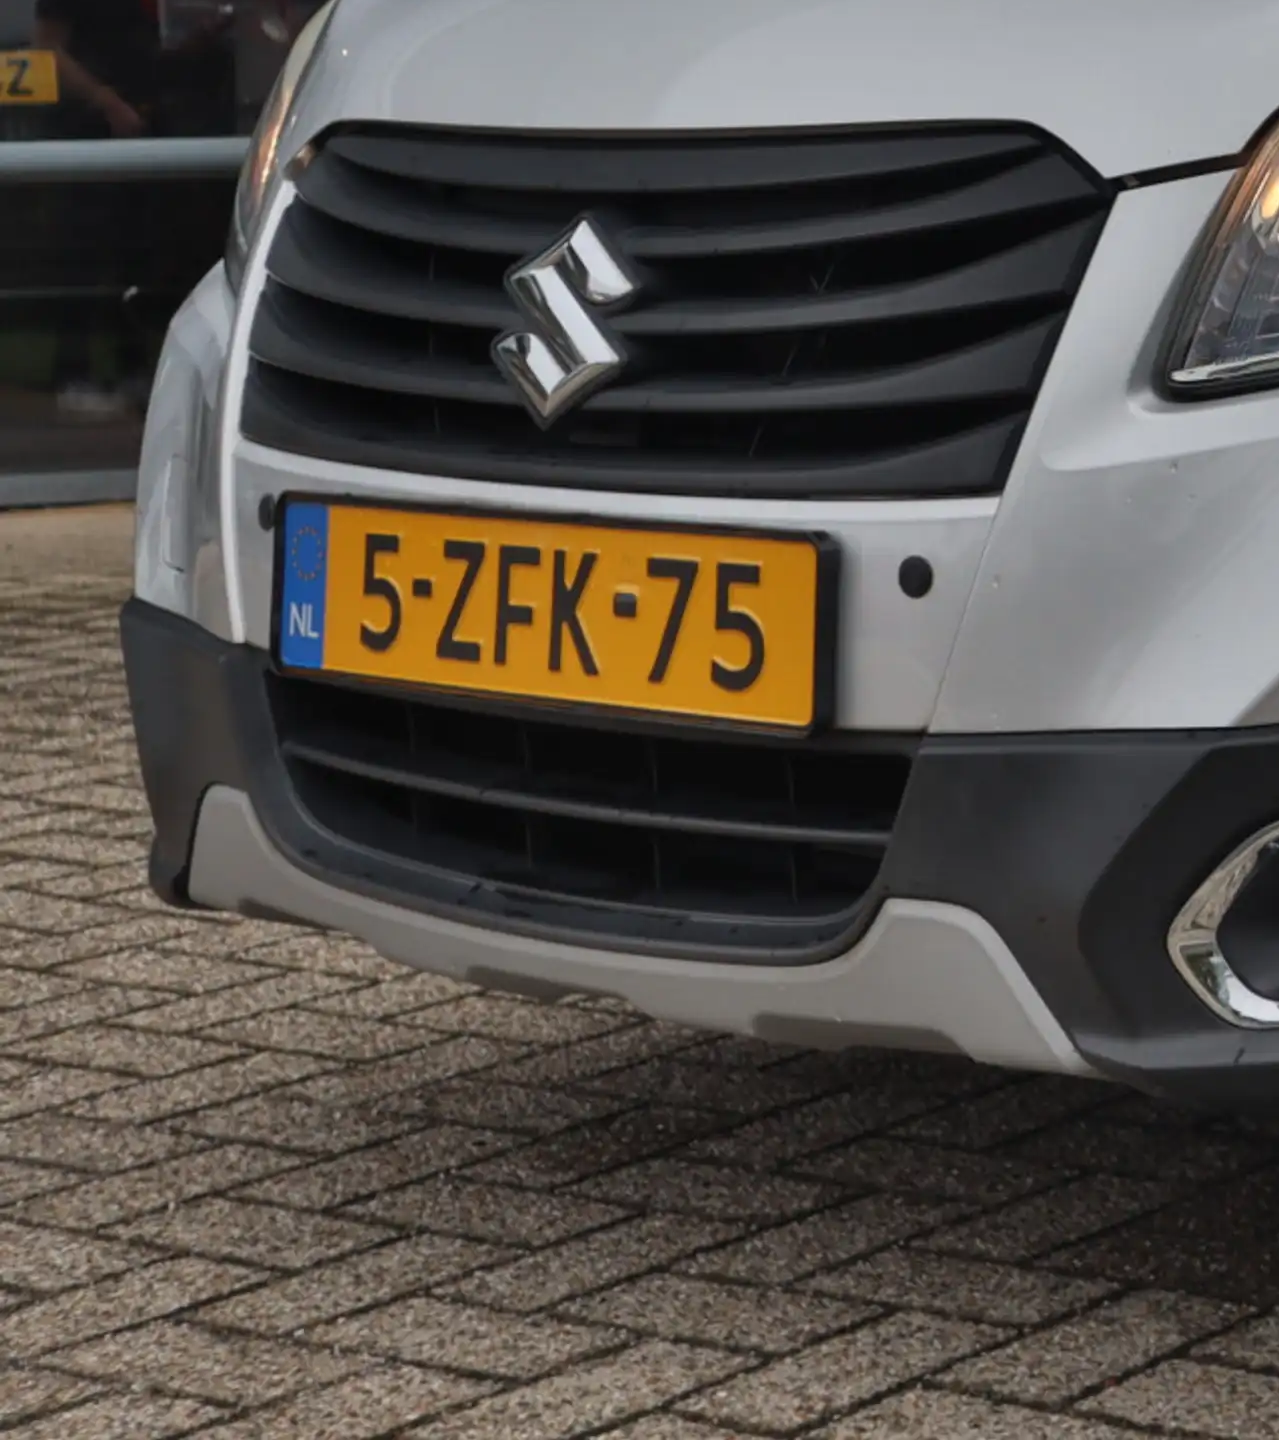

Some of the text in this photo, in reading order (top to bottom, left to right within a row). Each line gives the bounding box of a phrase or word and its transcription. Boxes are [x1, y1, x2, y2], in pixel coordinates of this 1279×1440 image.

[0, 57, 35, 98] Z
[288, 602, 320, 640] NL
[359, 533, 766, 692] 5-ZFK-75
